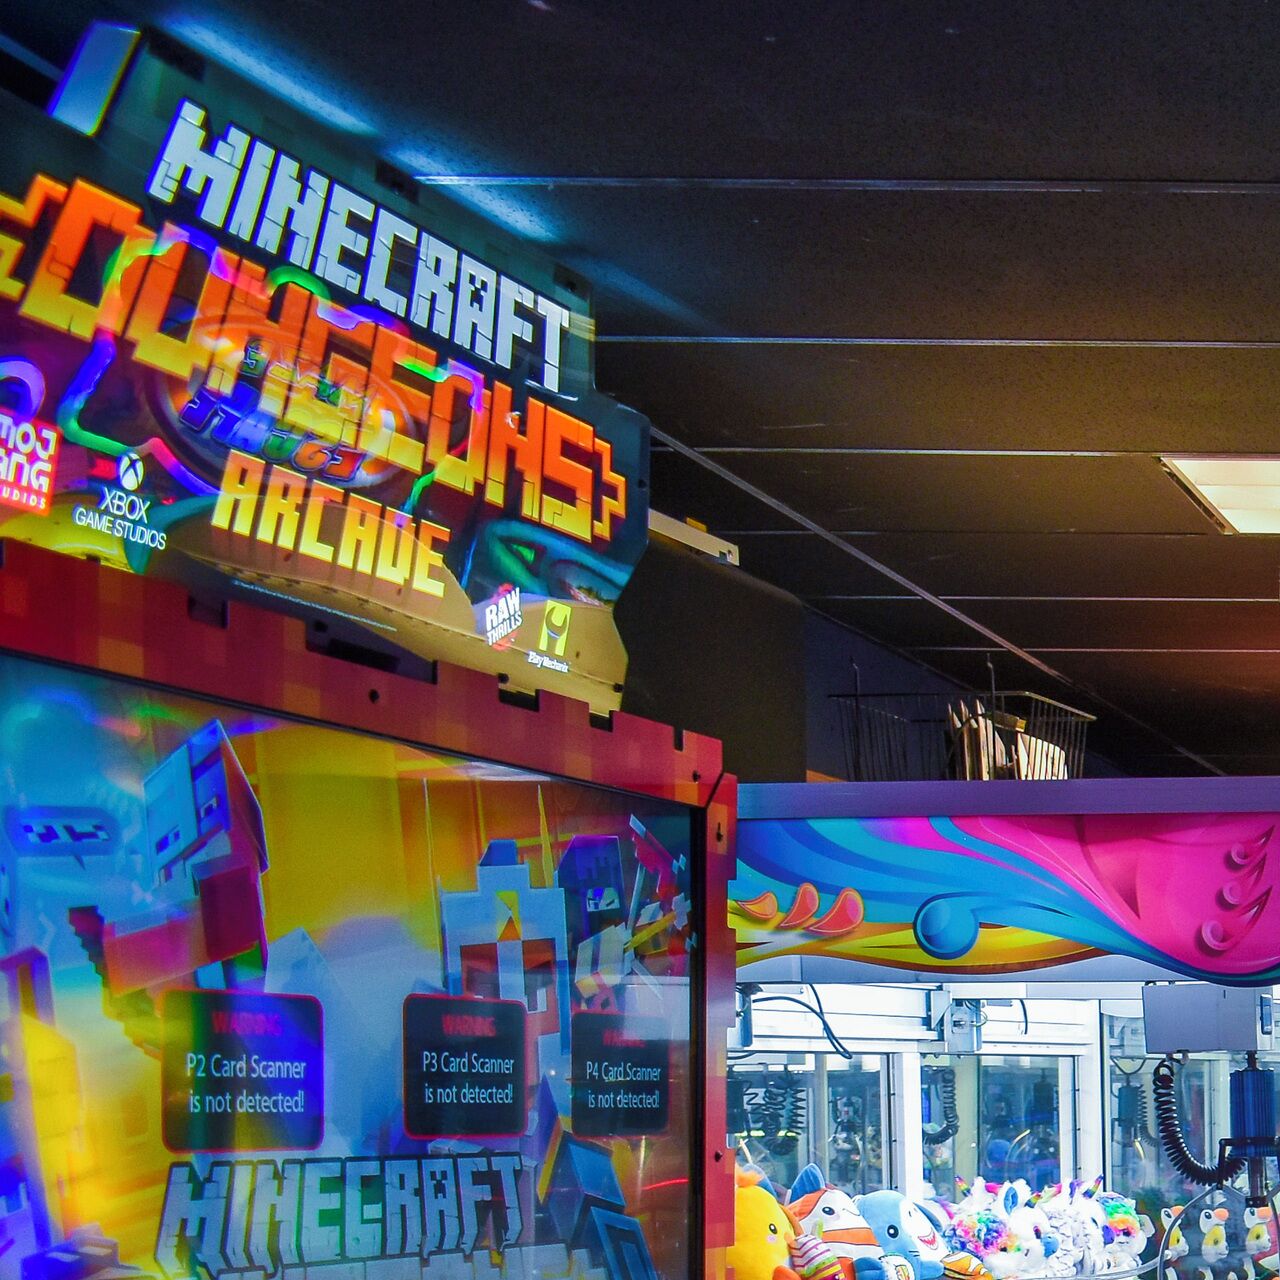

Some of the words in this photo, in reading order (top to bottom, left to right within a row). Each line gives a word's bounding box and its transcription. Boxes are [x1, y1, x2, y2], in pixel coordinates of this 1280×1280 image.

[148, 97, 570, 393] MINECRAFT
[19, 178, 593, 543] DUNGEONS
[0, 488, 48, 510] UDIOS
[100, 488, 151, 524] XBOX
[75, 507, 113, 535] GAME
[114, 520, 167, 550] STUDIOS
[209, 449, 450, 599] ARCADE
[485, 587, 522, 628] RAW
[487, 612, 523, 646] THRILLS
[186, 1052, 206, 1077] P2
[211, 1054, 246, 1077] Card
[251, 1055, 306, 1078] Scanner
[423, 1051, 438, 1072] P3
[441, 1052, 468, 1072] Card
[472, 1053, 514, 1074] Scanner
[586, 1061, 599, 1080] P4
[601, 1062, 624, 1080] Card
[626, 1063, 661, 1081] Scanner
[189, 1089, 201, 1112] is
[206, 1092, 232, 1112] not
[236, 1090, 305, 1113] detected!
[425, 1083, 434, 1103] is
[437, 1086, 458, 1104] not
[461, 1084, 513, 1104] detected!
[588, 1090, 597, 1107] is
[598, 1092, 614, 1108] not
[617, 1091, 660, 1108] detected!
[155, 1154, 526, 1274] MINECRAFT
